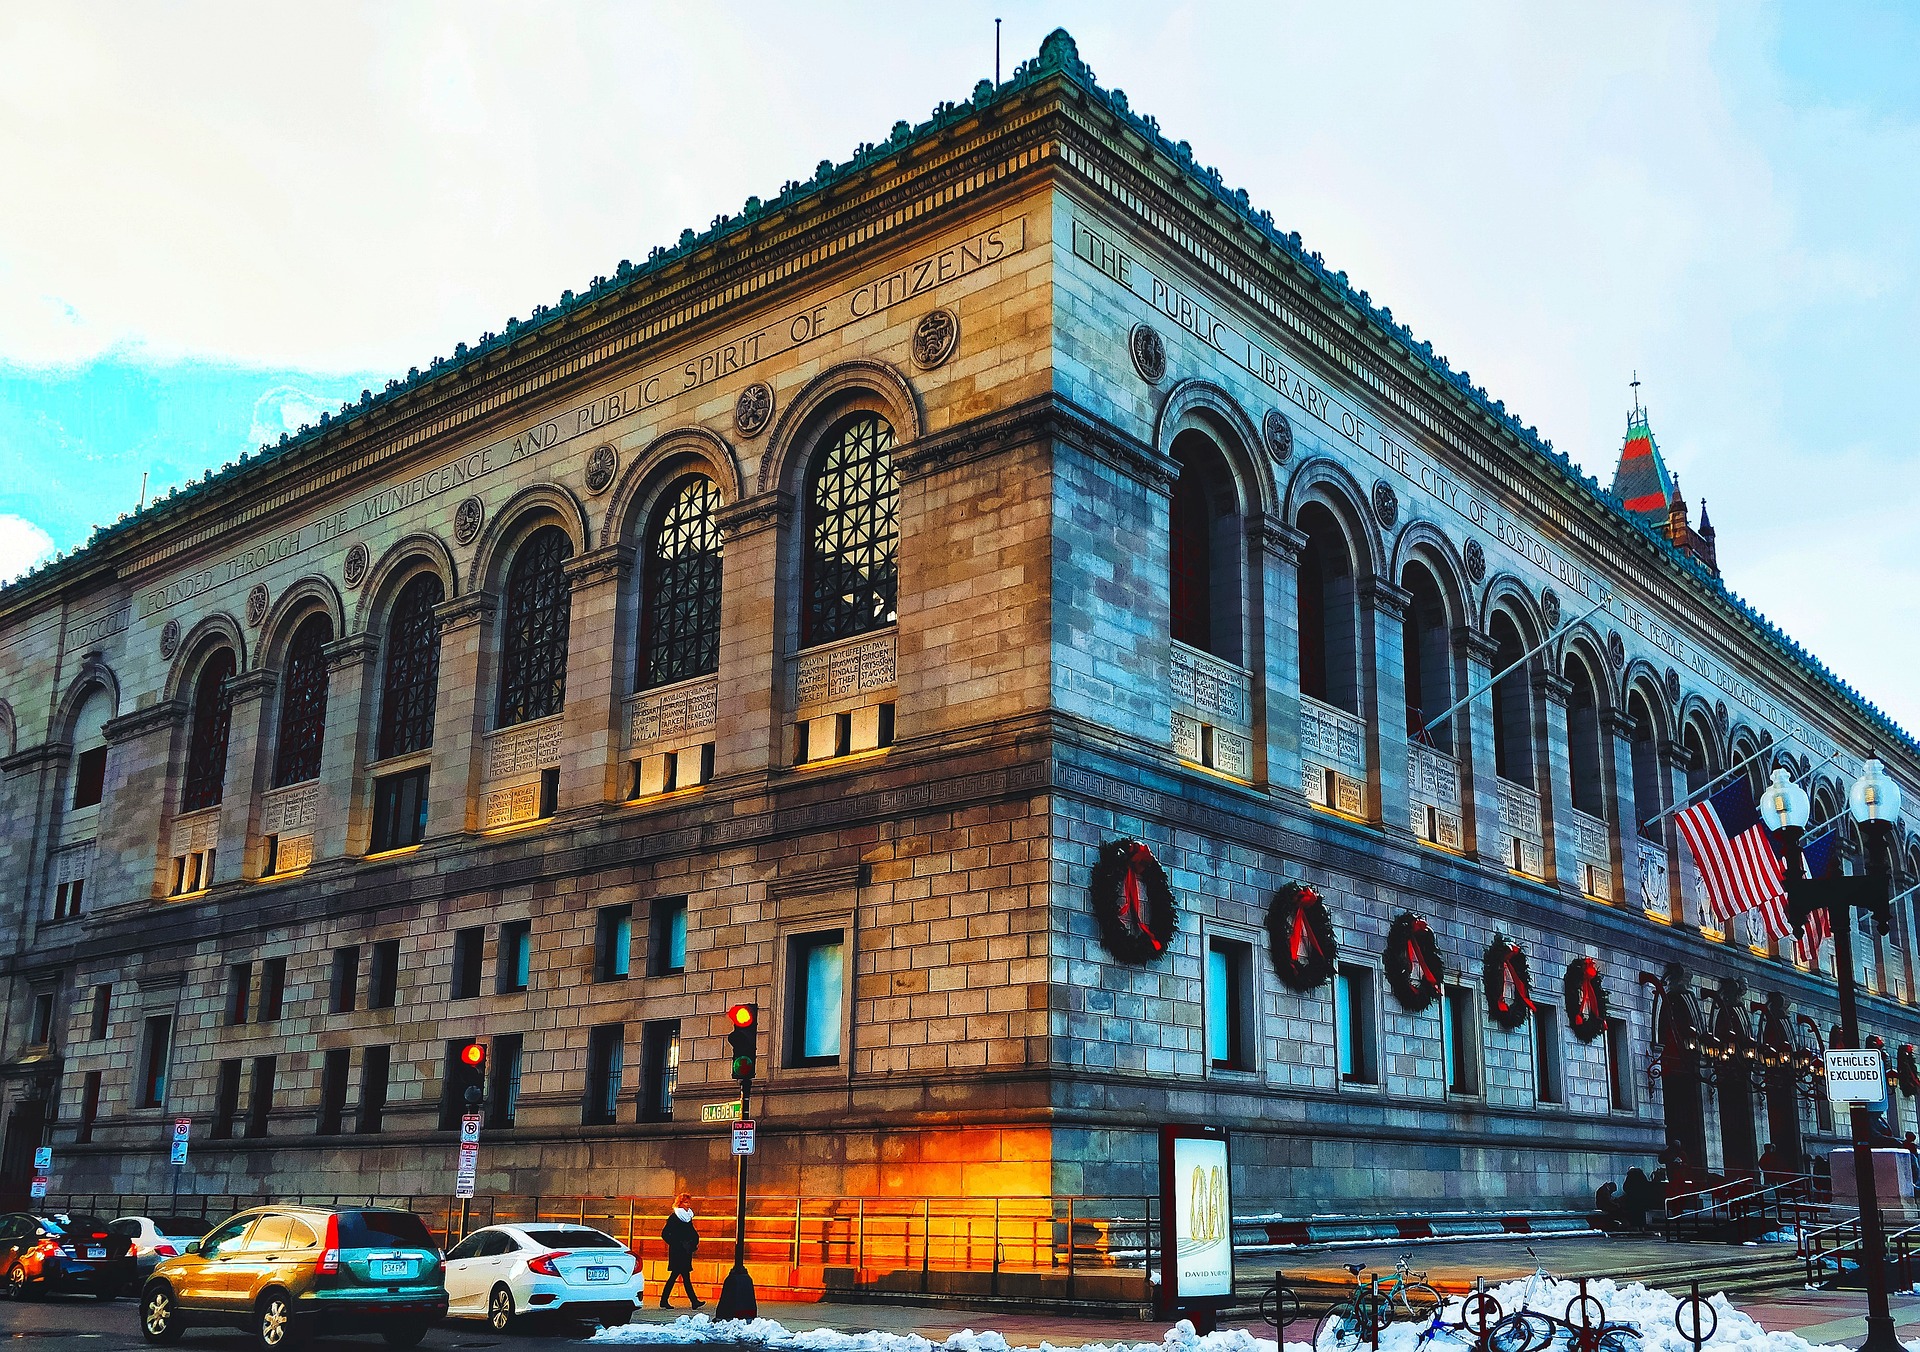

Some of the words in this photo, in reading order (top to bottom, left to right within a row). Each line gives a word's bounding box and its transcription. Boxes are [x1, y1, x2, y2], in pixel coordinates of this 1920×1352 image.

[149, 571, 213, 610] FOUNDED
[225, 535, 300, 581] THROUGH
[314, 512, 348, 545] THE
[361, 449, 493, 528] MUNIFICENCE
[510, 422, 559, 462] AND
[576, 376, 660, 434] PUBLIC
[683, 331, 767, 389] SPIRIT
[790, 306, 828, 343] OF
[850, 230, 1005, 317] CITIZENS
[1082, 228, 1133, 288] THE
[1152, 278, 1227, 351] PUBLIC
[1247, 344, 1330, 420] LIBRARY
[1341, 412, 1366, 444] OF
[1379, 434, 1410, 475] THE
[1420, 466, 1460, 507] CITY
[1469, 497, 1488, 527] OF
[1497, 517, 1553, 574] BOSTON
[1558, 560, 1592, 597] BUILT
[1599, 588, 1613, 612] BY
[1621, 603, 1645, 635] THE
[1650, 623, 1685, 660] PEOPLE
[1691, 653, 1711, 679] AND
[1716, 667, 1762, 712] DEDICATED
[1766, 701, 1778, 723] TO
[861, 650, 888, 660] ORIGEN
[798, 656, 823, 667] CALVIN
[861, 675, 893, 687] AQVINAS
[830, 685, 850, 694] ELIOT
[687, 718, 713, 729] BARROW
[1830, 1056, 1876, 1067] VEHICLES
[1830, 1070, 1878, 1080] EXCLUDED
[704, 1105, 734, 1120] BLAGDEN
